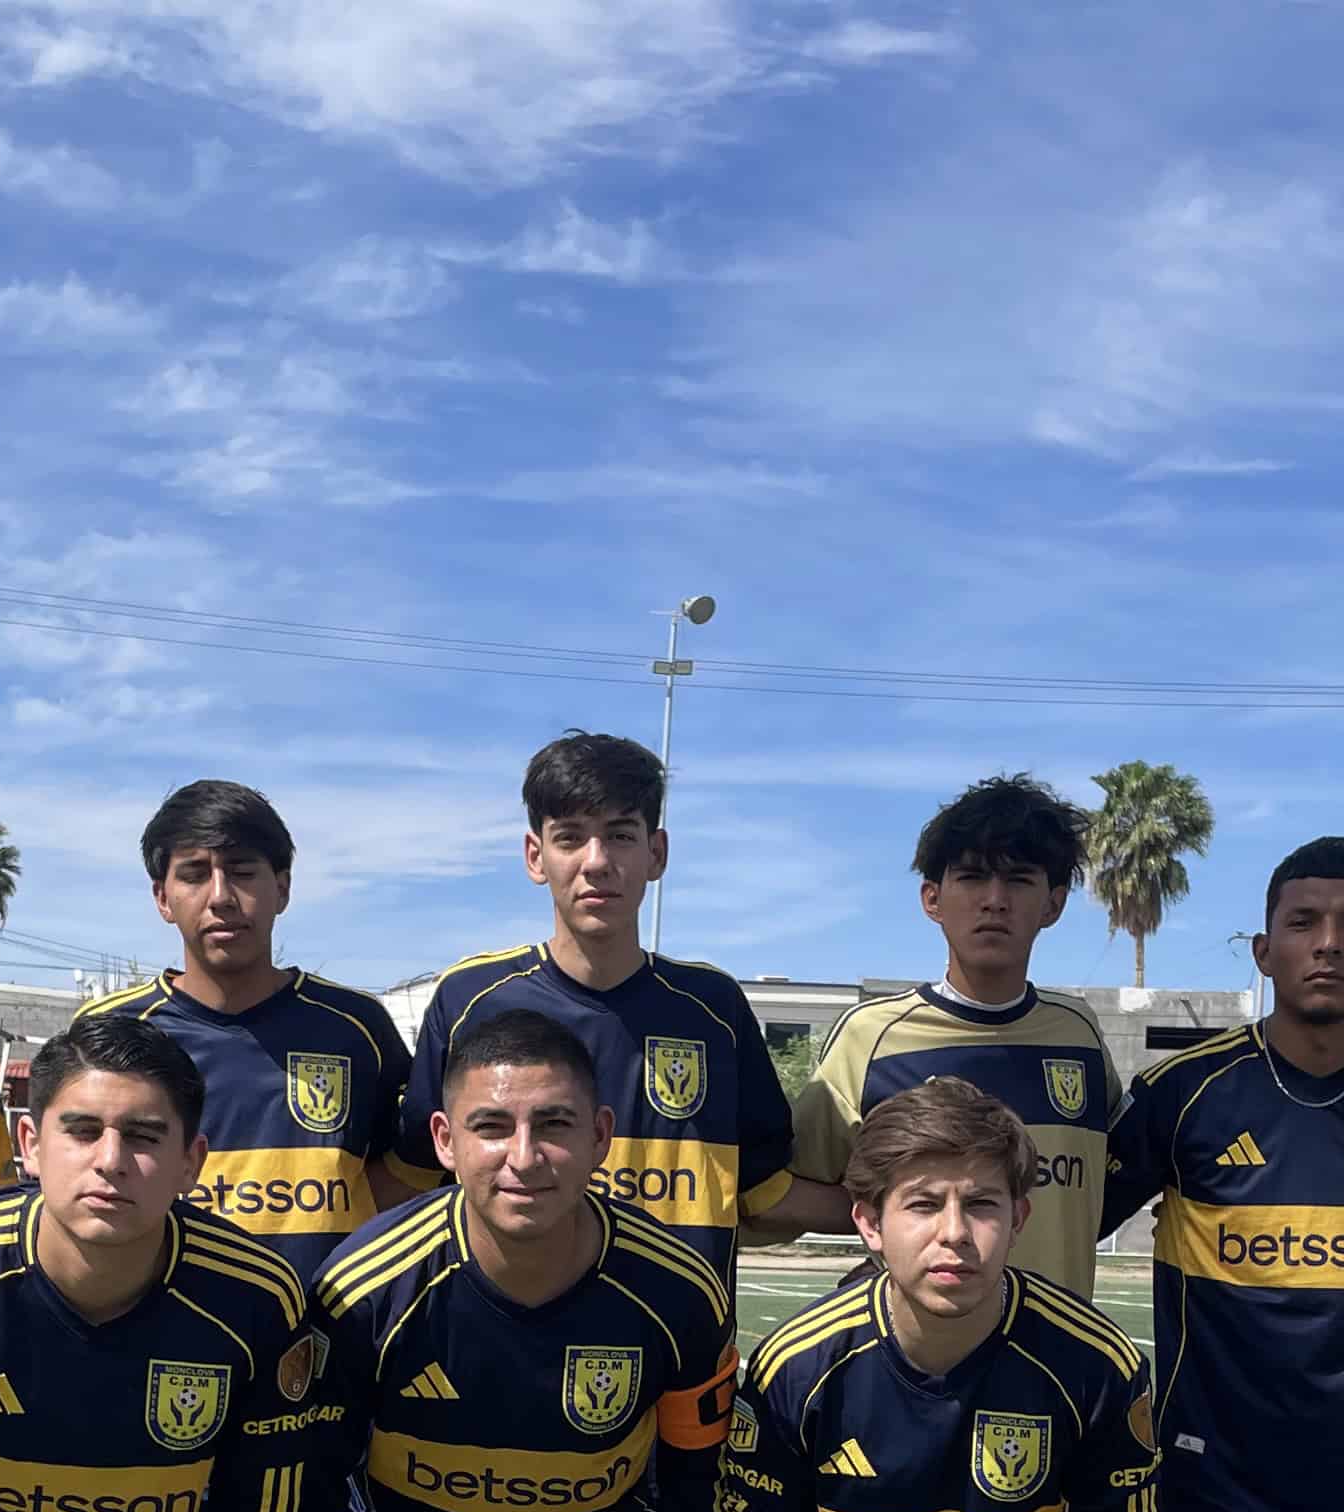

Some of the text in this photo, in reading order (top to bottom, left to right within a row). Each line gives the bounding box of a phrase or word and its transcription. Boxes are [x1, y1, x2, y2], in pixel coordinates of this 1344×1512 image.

[585, 1360, 623, 1370] C.D.M
[169, 1377, 209, 1388] C.D.M
[242, 1403, 346, 1436] CETROGAR
[993, 1426, 1031, 1438] C.D.M
[407, 1452, 632, 1507] betsson
